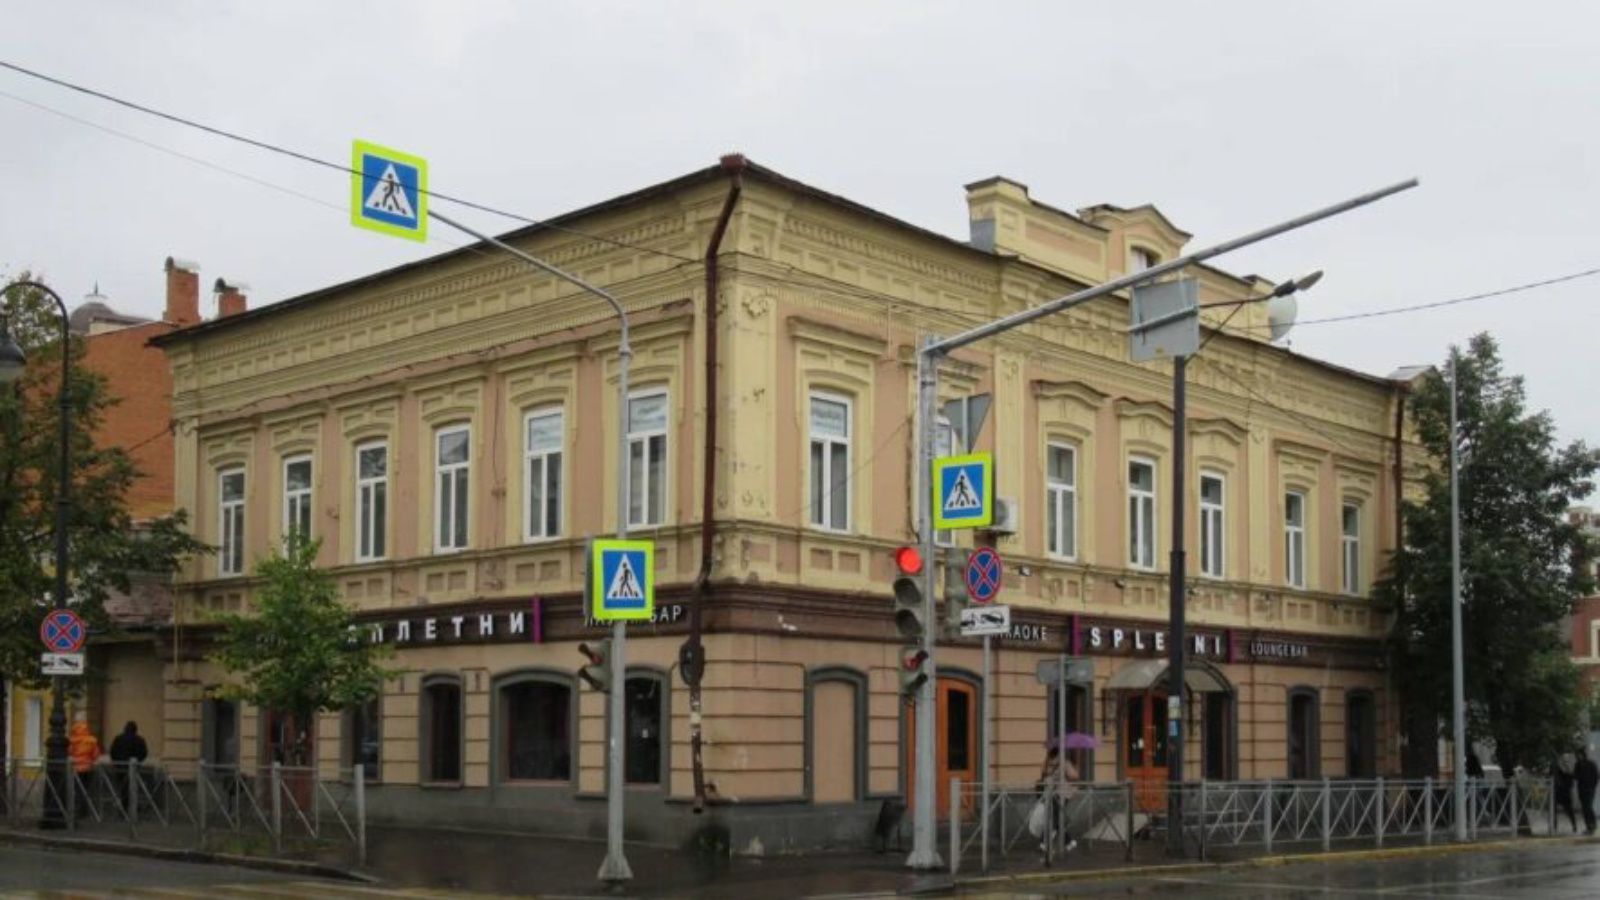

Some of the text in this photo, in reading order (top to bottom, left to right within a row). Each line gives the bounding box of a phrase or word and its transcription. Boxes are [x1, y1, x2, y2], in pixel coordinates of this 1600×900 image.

[1091, 627, 1220, 655] SPLENI
[1251, 641, 1308, 657] LOUNGE BAR
